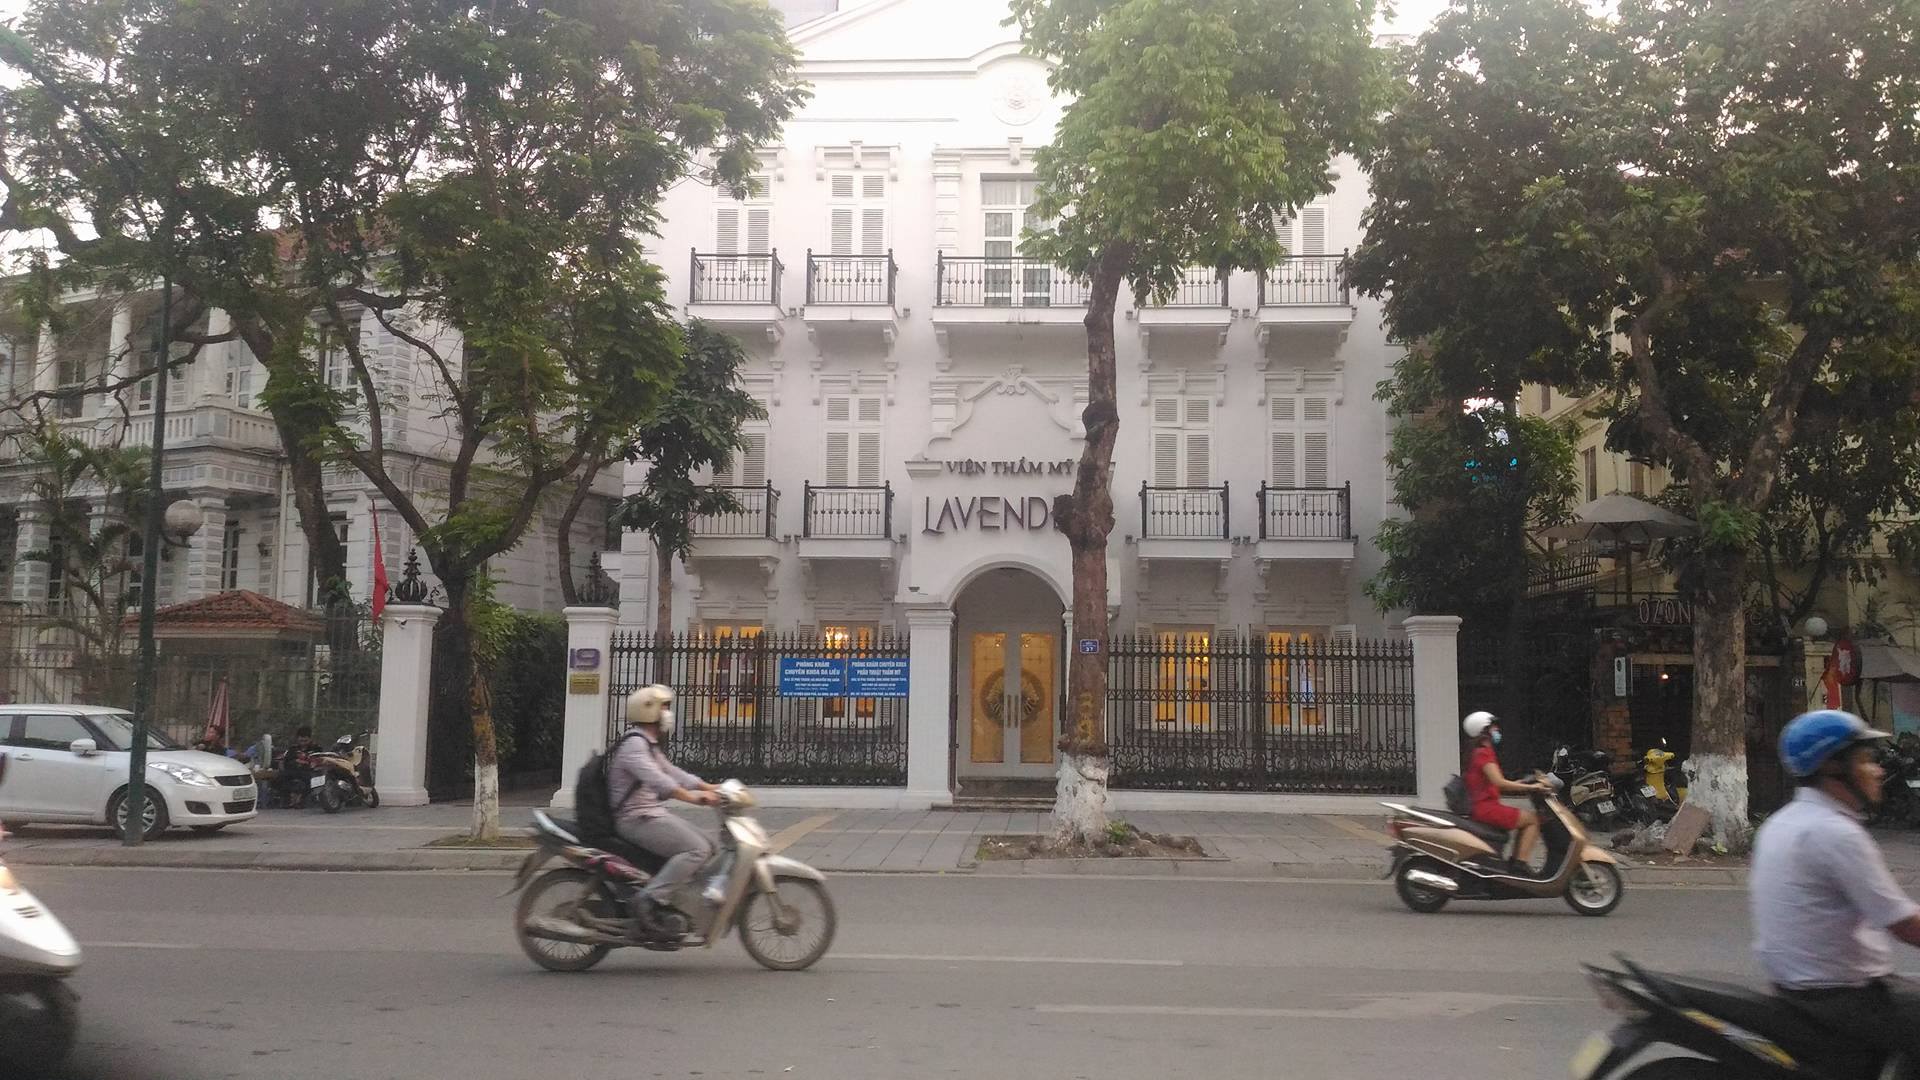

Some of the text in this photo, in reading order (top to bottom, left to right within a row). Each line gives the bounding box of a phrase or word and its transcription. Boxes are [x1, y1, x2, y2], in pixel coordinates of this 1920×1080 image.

[946, 456, 1074, 476] VIỆN THẨM MỸ
[922, 496, 1061, 534] LAVEND
[1639, 599, 1696, 624] OZON
